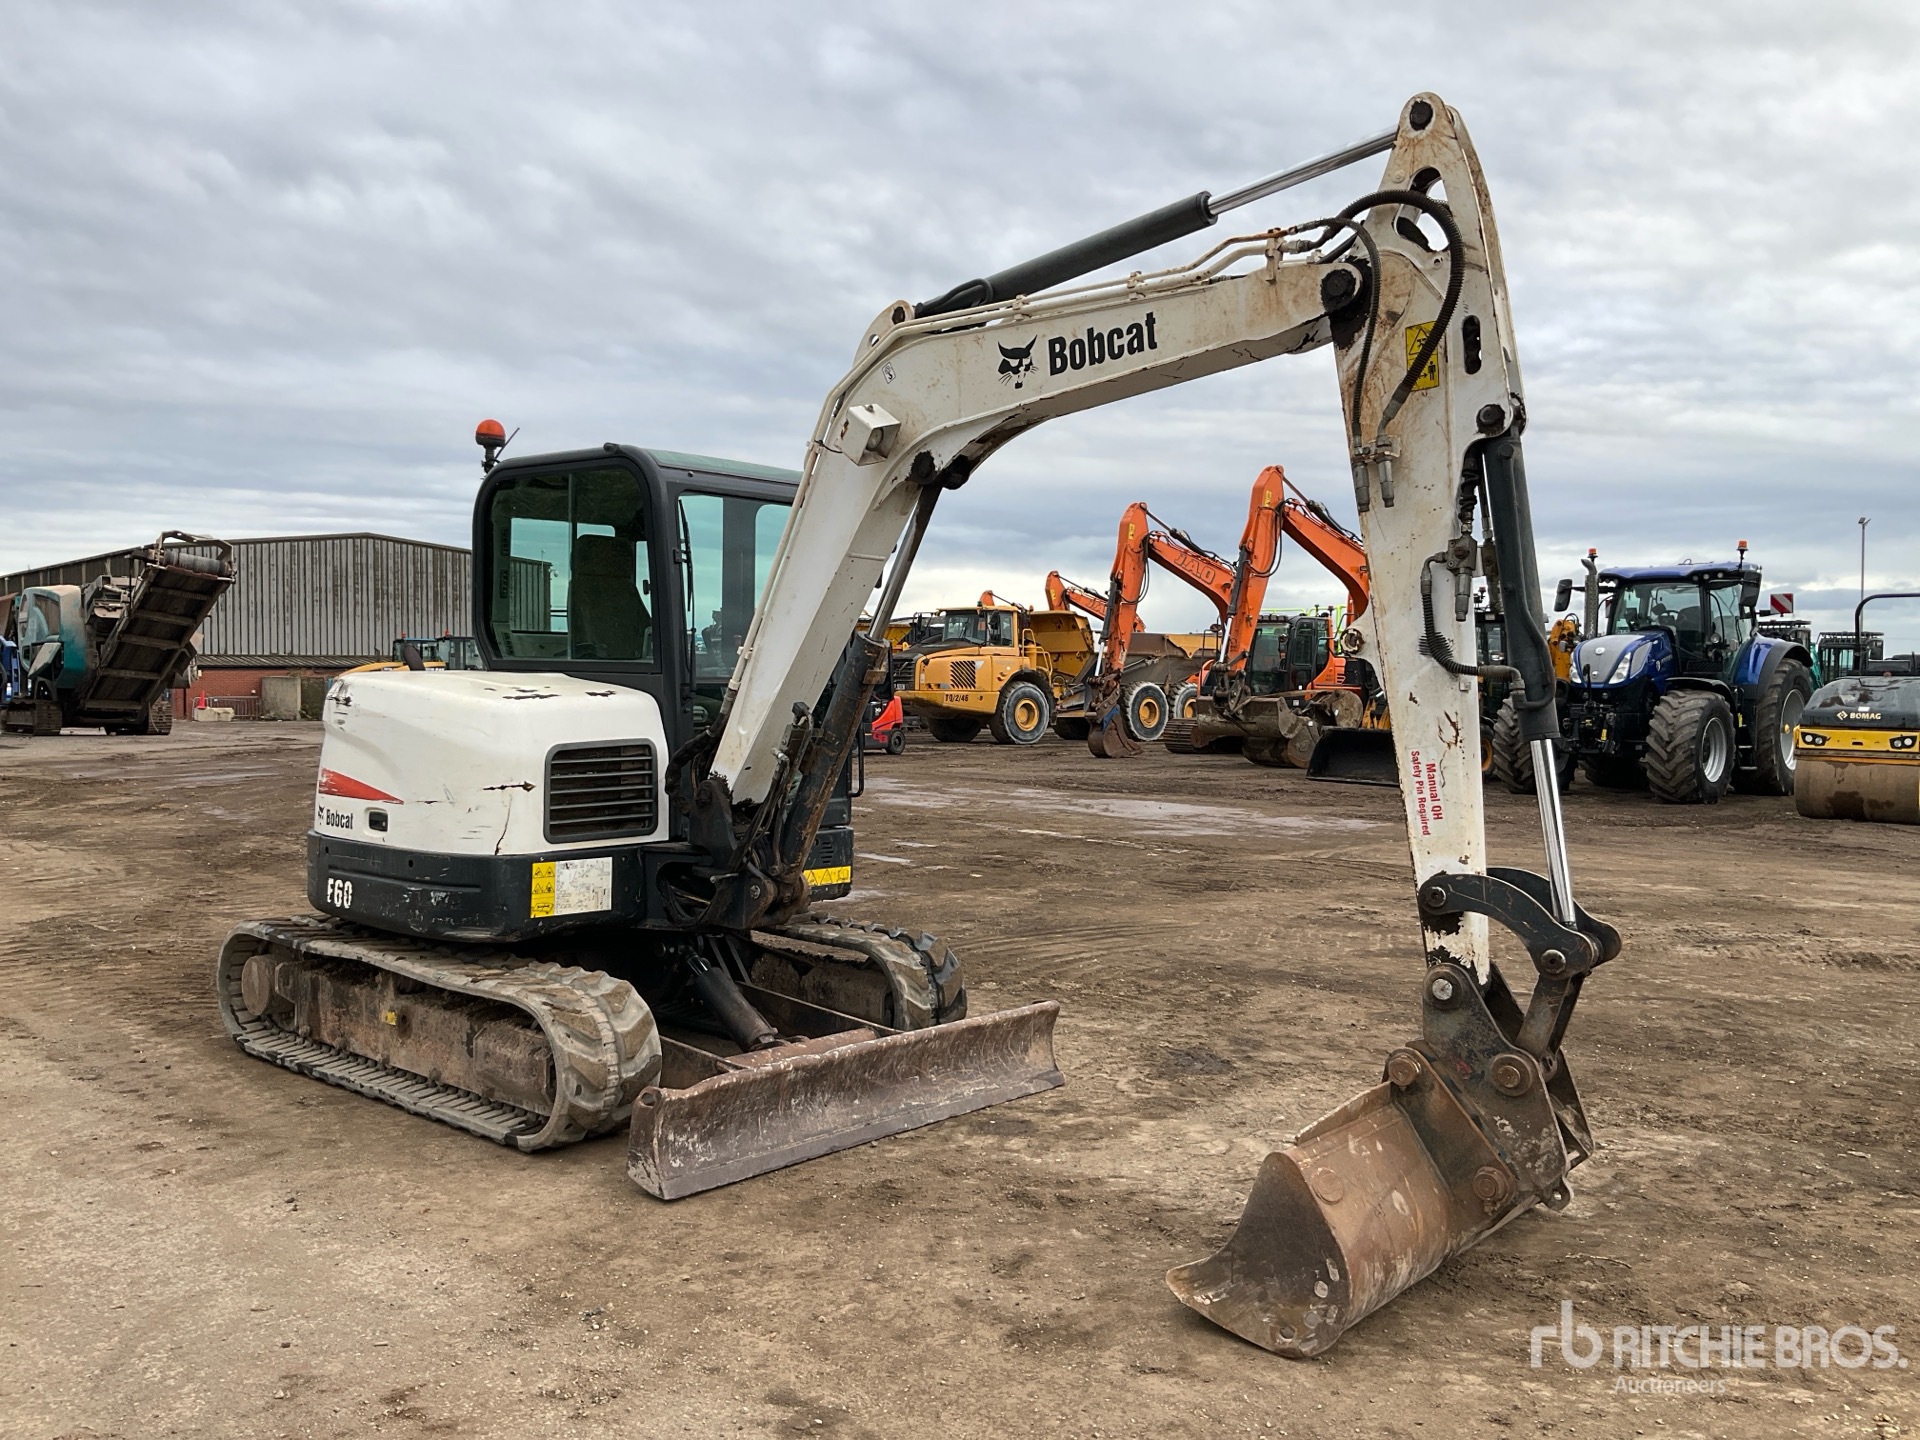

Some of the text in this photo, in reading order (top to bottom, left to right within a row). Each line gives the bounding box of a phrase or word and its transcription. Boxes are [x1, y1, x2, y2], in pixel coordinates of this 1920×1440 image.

[1048, 311, 1157, 376] Bobcat
[1849, 712, 1882, 720] BOMAG
[326, 809, 354, 829] Bobcat
[1411, 750, 1431, 836] Safety Pin Required
[1426, 763, 1443, 820] Manual QH
